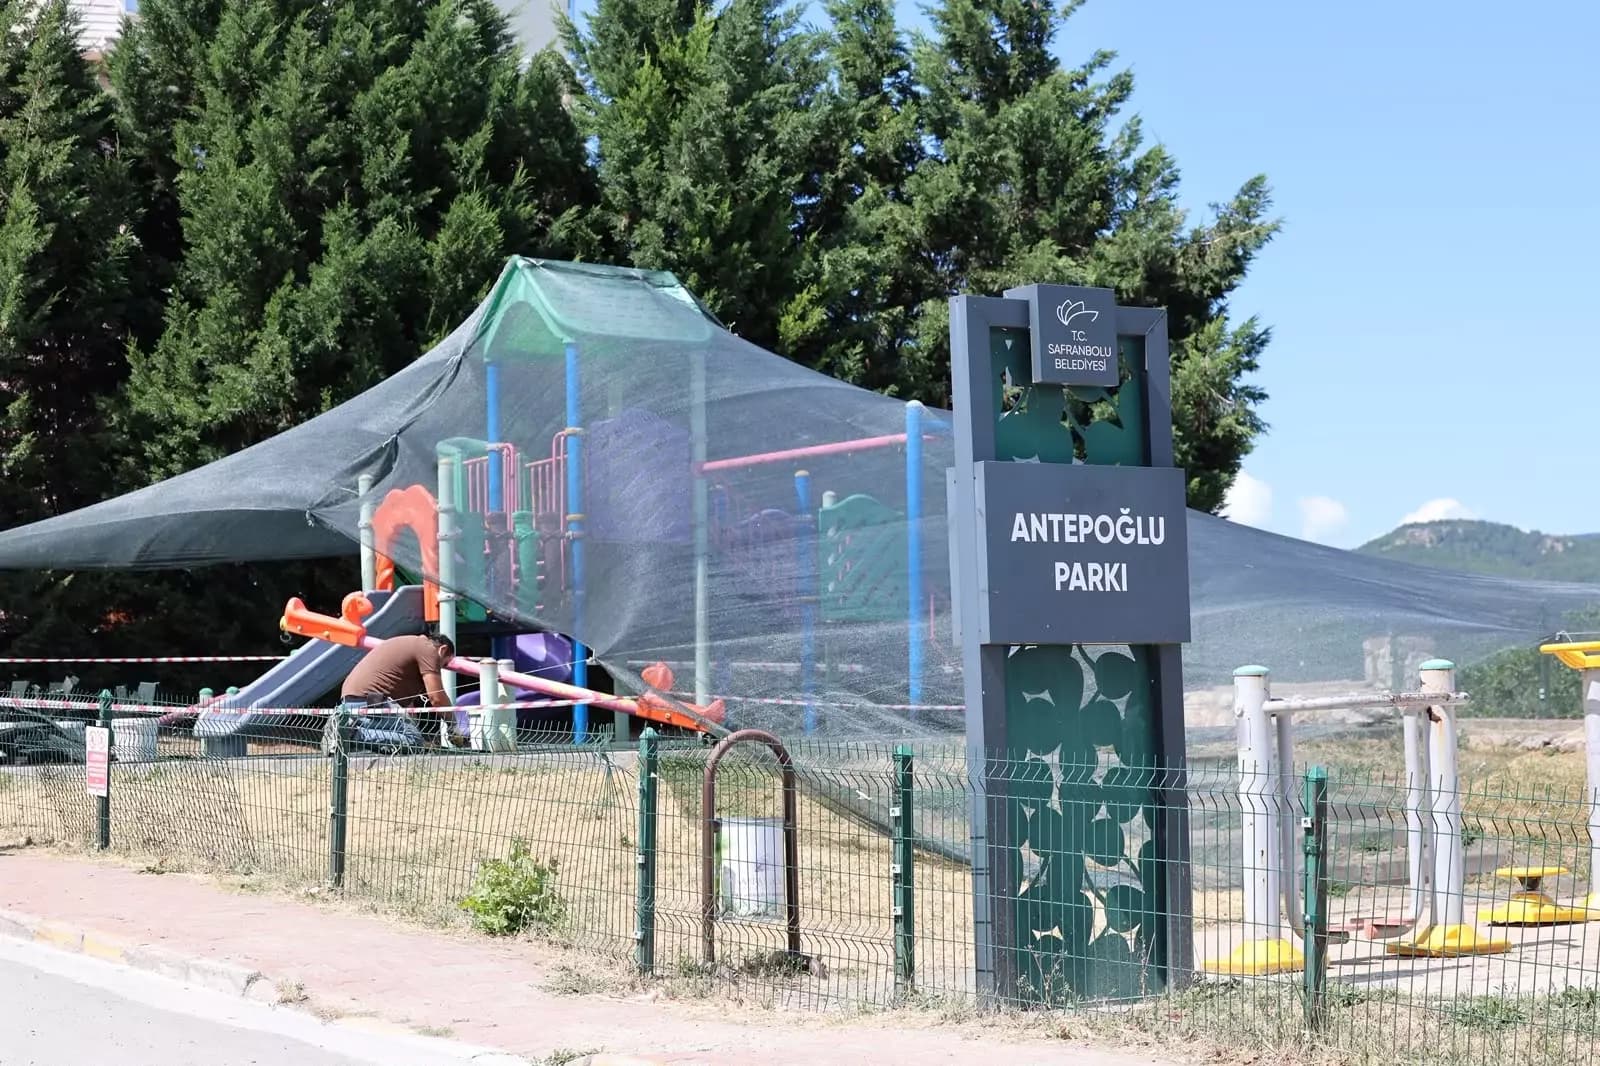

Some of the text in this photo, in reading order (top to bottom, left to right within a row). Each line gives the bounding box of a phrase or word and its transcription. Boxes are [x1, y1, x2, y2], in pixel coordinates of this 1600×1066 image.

[1071, 330, 1087, 341] T.C.
[1048, 344, 1111, 356] SAFRANBOLU
[1055, 358, 1106, 371] BELEDİYESİ
[1010, 508, 1165, 545] ANTEPOĞLU
[1054, 562, 1128, 592] PARKI
